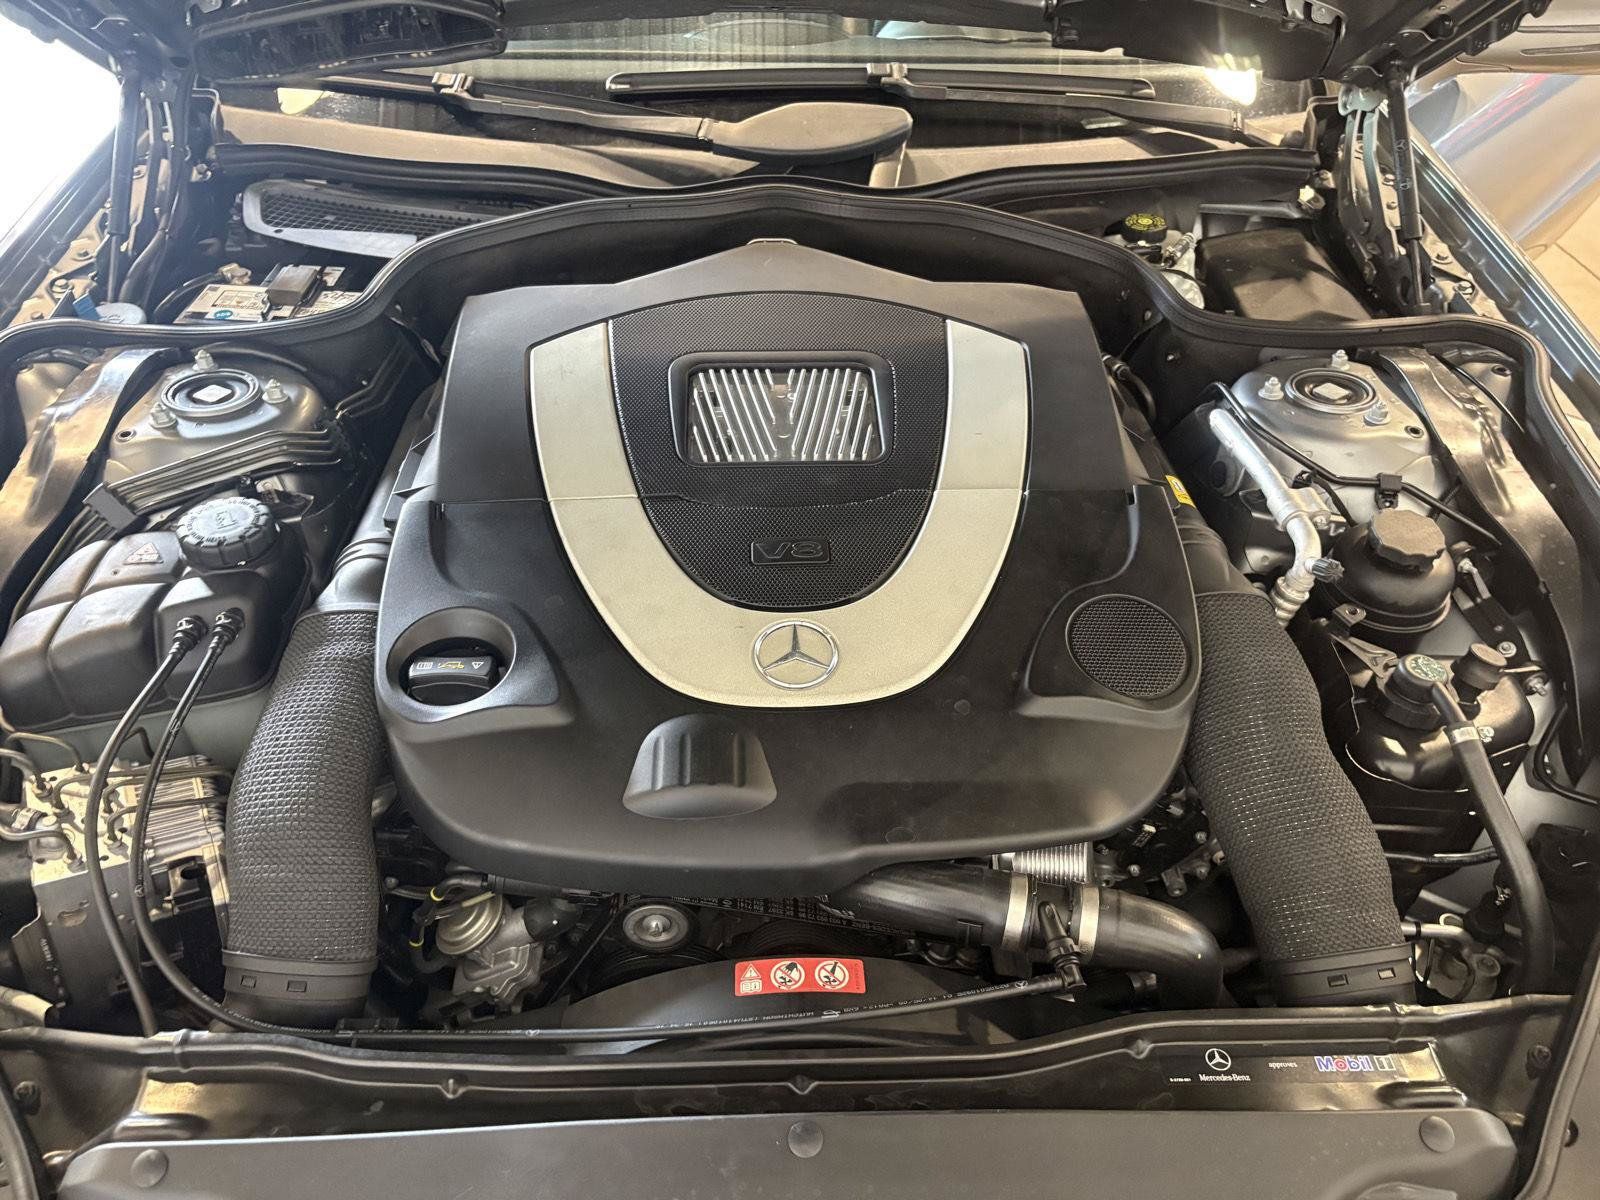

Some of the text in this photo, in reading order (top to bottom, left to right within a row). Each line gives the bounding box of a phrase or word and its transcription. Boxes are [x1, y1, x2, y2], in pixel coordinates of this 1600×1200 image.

[755, 541, 824, 559] V8
[1268, 1062, 1298, 1070] approves
[1314, 1056, 1374, 1071] Mobil
[1199, 1074, 1251, 1082] Mercedes-Benz
